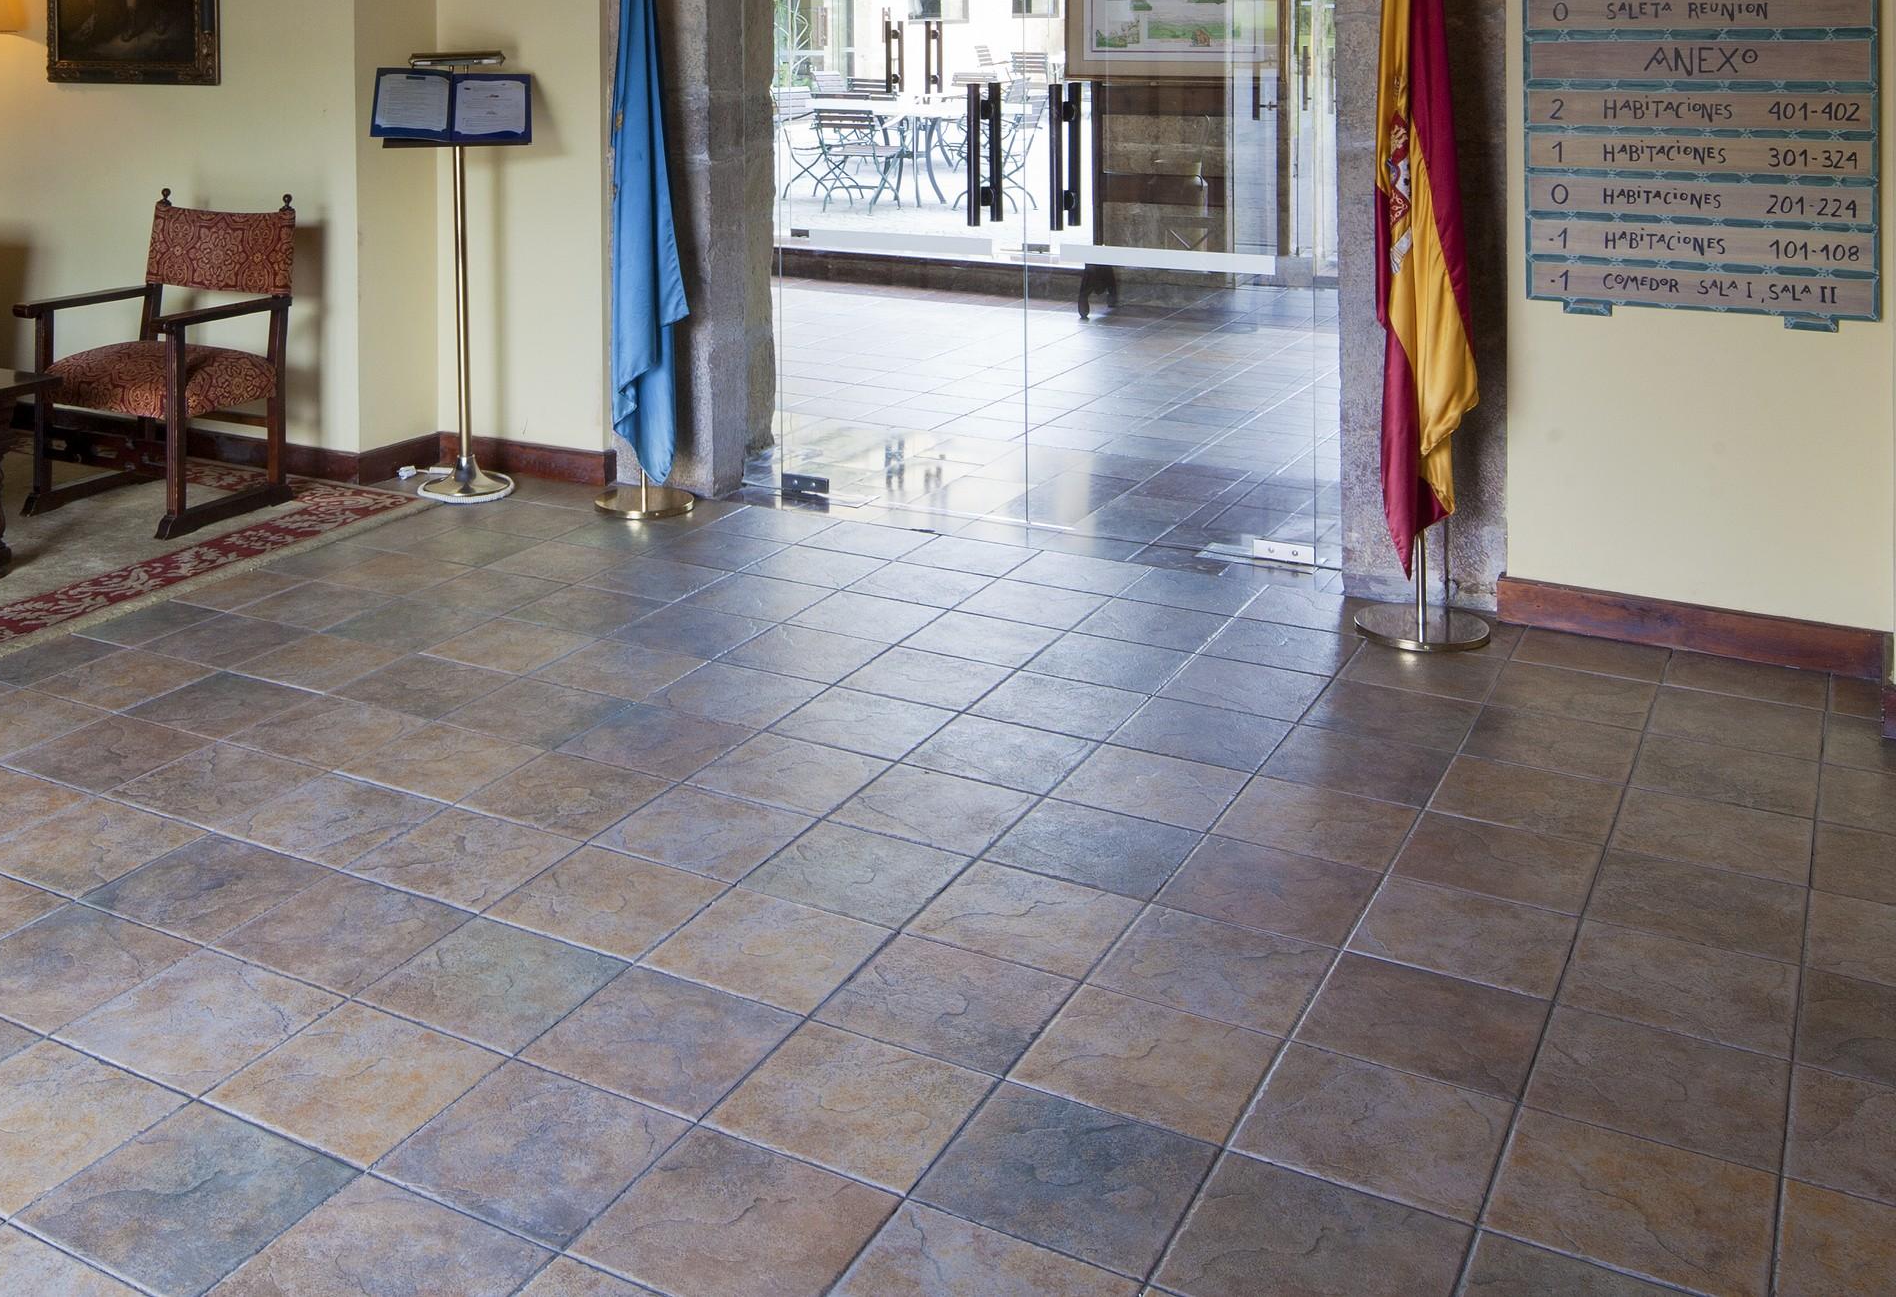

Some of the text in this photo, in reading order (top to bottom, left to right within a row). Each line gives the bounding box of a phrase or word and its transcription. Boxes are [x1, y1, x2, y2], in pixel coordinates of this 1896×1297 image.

[1607, 2, 1672, 19] SALETA
[1644, 47, 1758, 76] ANEXO
[1550, 95, 1860, 123] 2 HABITACIONES 401-402
[1552, 140, 1857, 169] 1 HABITACIONES 301-324
[1603, 186, 1721, 210] HABITACIONES
[1766, 195, 1856, 218] 201-224
[1549, 228, 1859, 261] -1 HABITACIONES 101-108
[1551, 270, 1569, 291] -1
[1603, 273, 1679, 293] COMEDOR
[1697, 280, 1738, 297] SALA
[1820, 286, 1837, 304] II
